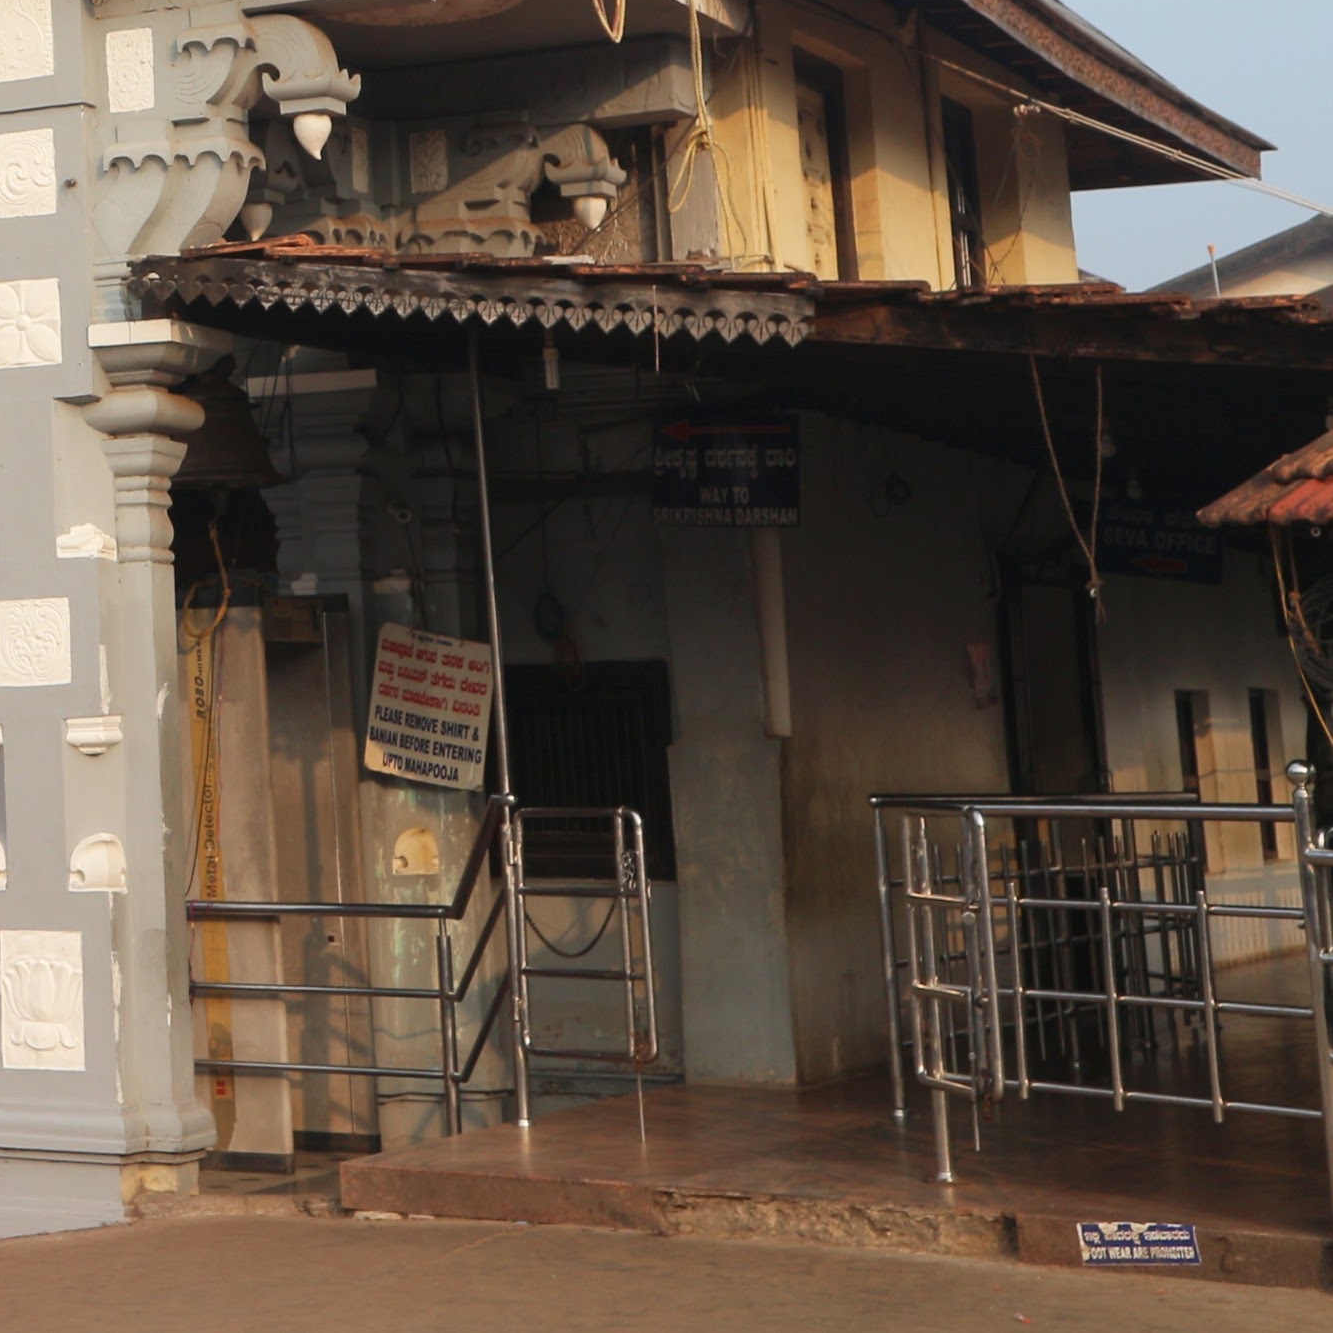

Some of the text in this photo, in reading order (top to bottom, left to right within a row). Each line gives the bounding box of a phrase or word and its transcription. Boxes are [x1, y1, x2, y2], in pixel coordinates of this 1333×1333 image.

[699, 485, 750, 504] WAY TO
[653, 506, 798, 525] SRIKRISHNA DARSHAN
[1103, 526, 1216, 554] SEVA OFFICE
[375, 705, 479, 742] PLEASE REMOVE SHIRT &
[369, 726, 482, 764] BANIAN BEFORE ENTERING
[382, 751, 459, 782] UPTO MAHAPOOJA
[206, 856, 217, 898] Metal
[1089, 1247, 1107, 1260] OOT
[1108, 1247, 1132, 1260] WEAR
[1133, 1247, 1149, 1259] ARE
